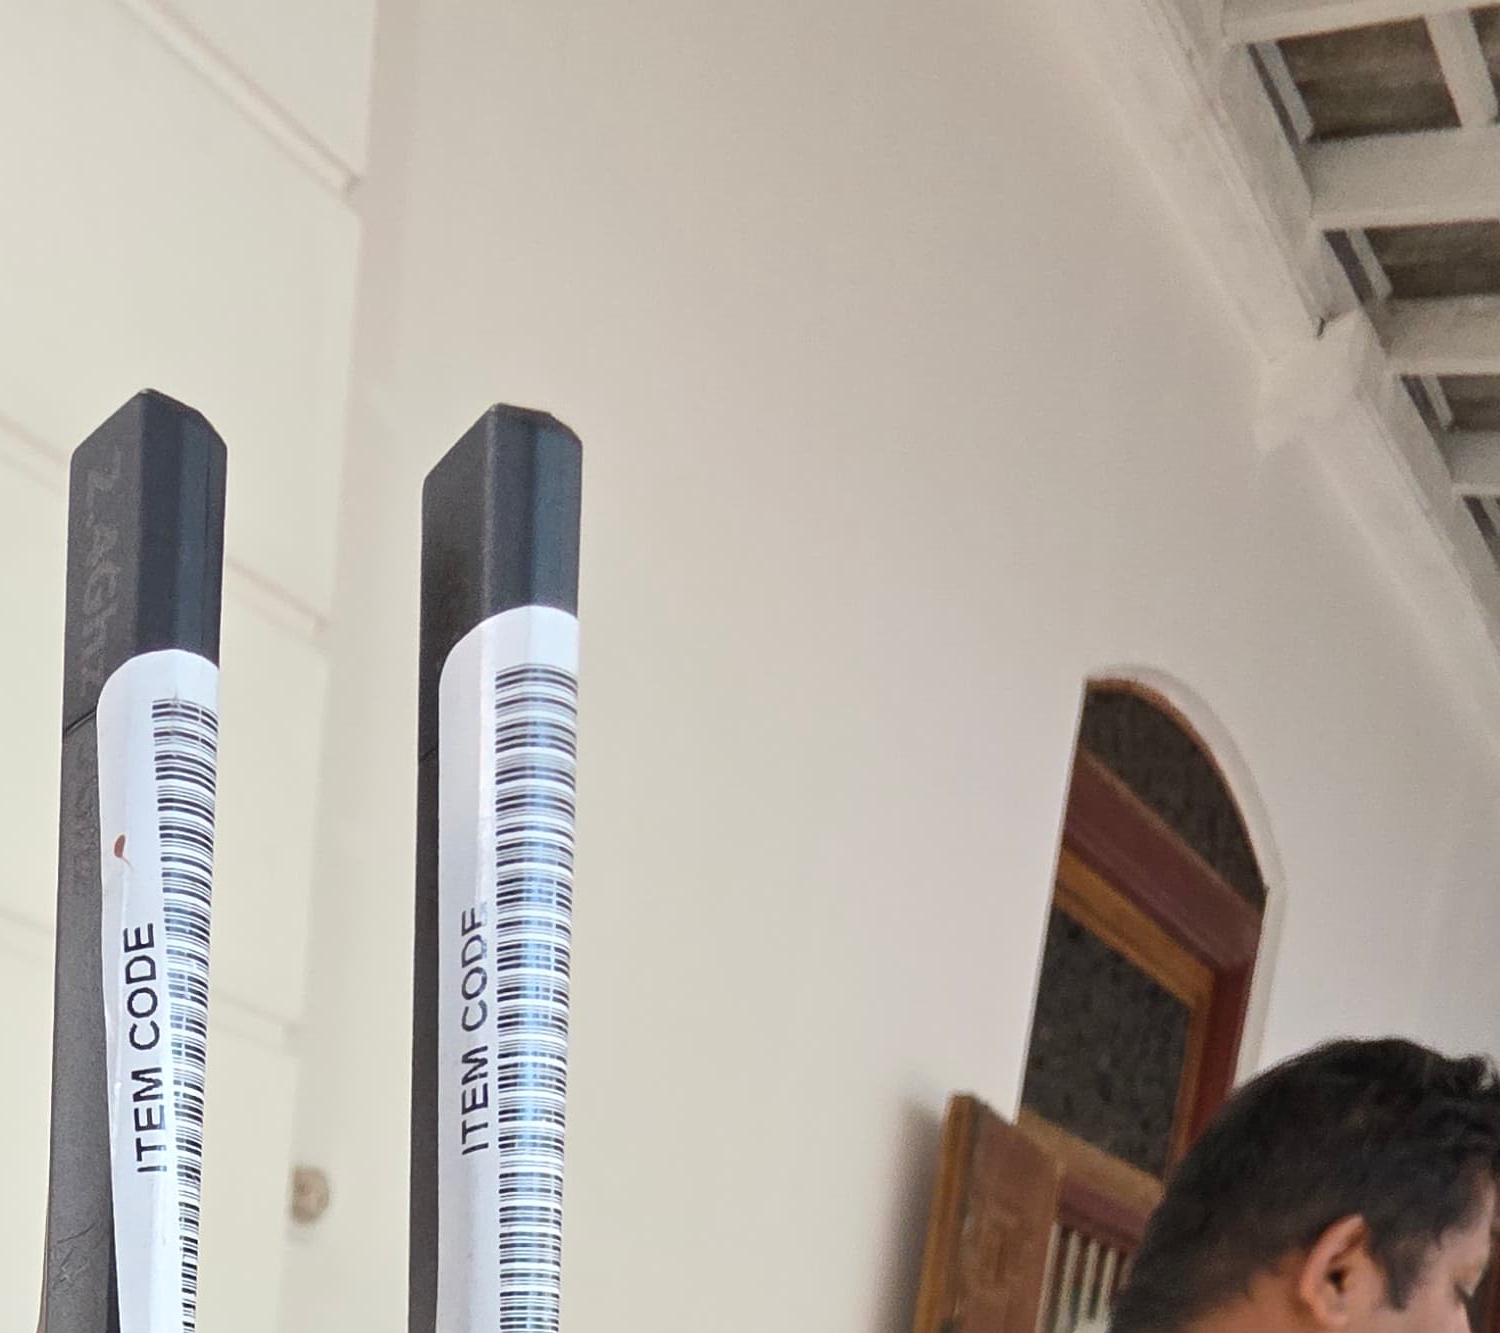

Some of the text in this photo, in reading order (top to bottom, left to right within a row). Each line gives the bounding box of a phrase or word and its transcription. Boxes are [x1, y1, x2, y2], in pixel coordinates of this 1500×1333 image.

[123, 923, 168, 1175] ITEM CODE
[461, 1046, 489, 1156] ITEM
